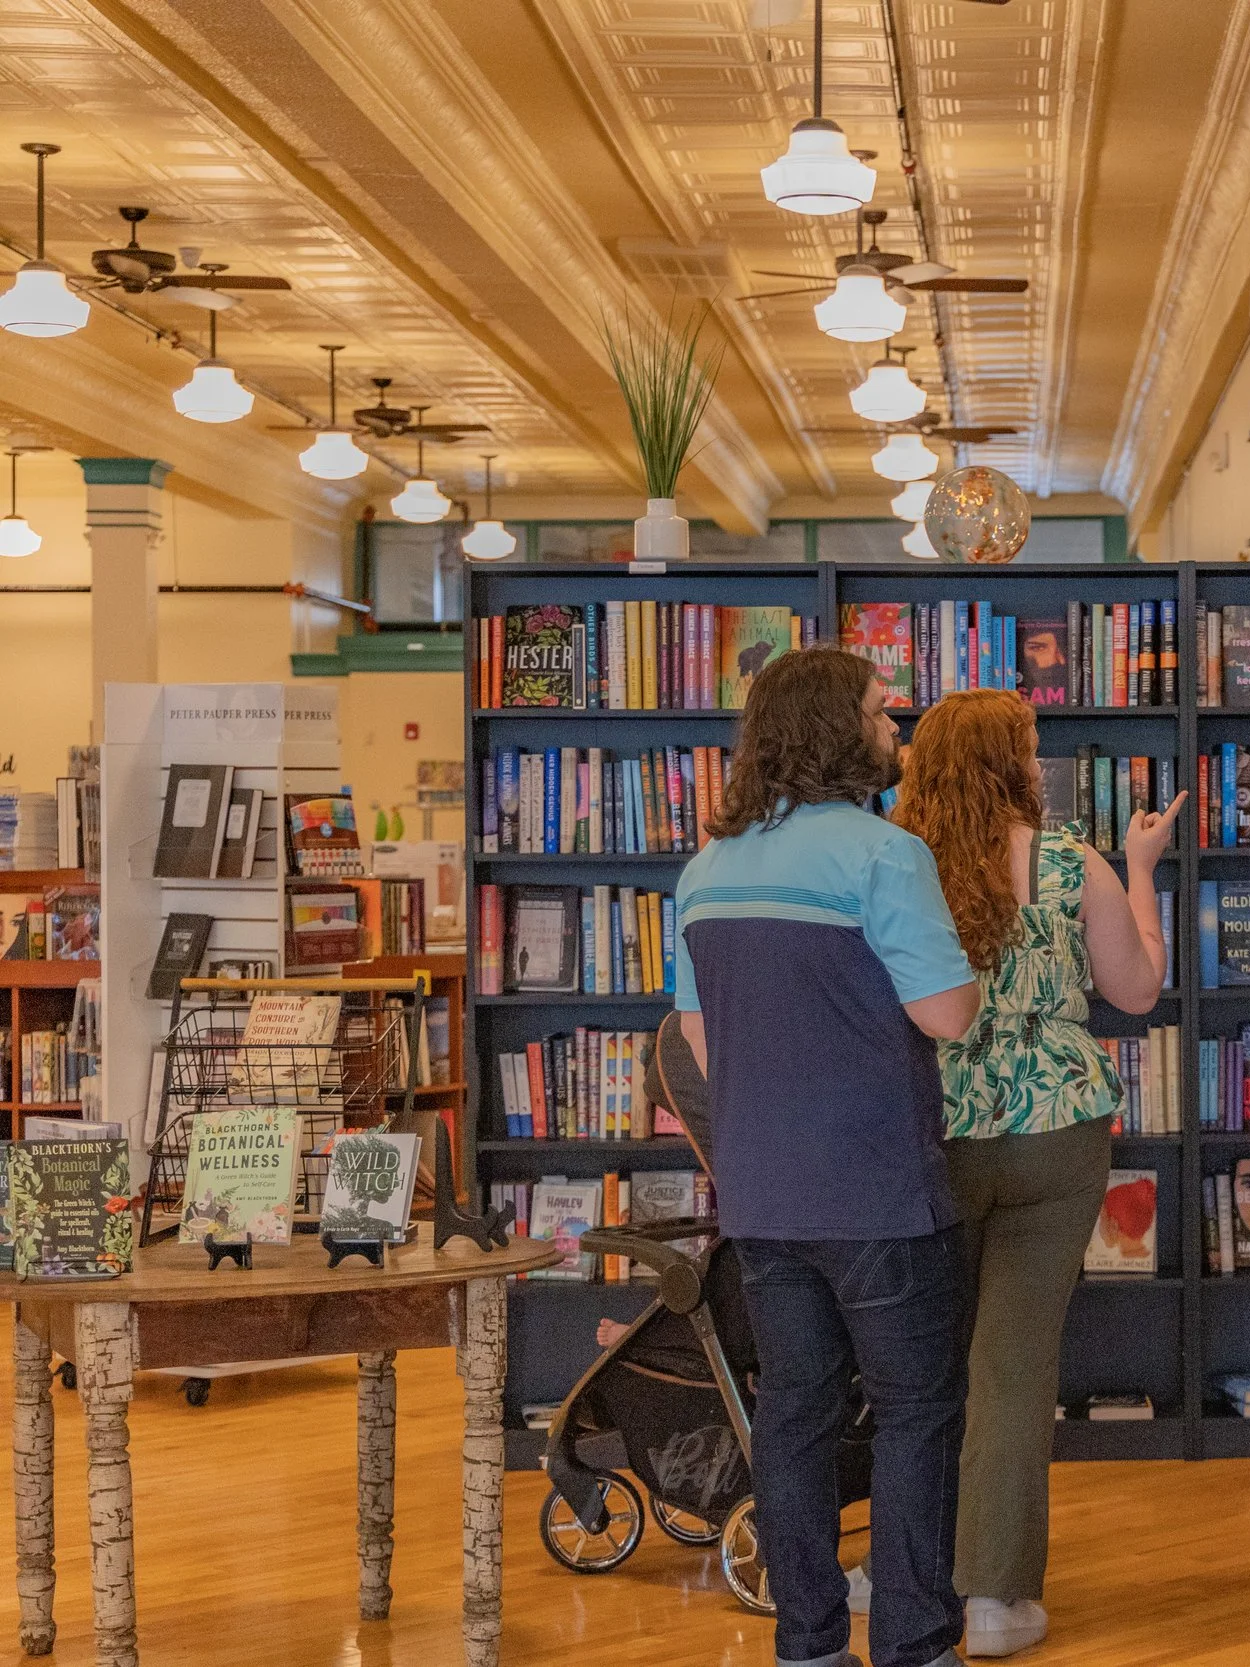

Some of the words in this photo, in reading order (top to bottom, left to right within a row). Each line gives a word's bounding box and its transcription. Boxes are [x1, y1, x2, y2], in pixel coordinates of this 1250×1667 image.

[587, 604, 596, 633] OTHER
[725, 610, 747, 625] THE
[754, 610, 783, 625] LAST
[730, 626, 781, 641] ANIMAL
[587, 637, 596, 662] BIRDS
[507, 645, 573, 670] HESTER
[1142, 671, 1152, 693] PARTNERS
[1164, 670, 1173, 692] PARTNERS
[1019, 686, 1066, 705] SAM
[170, 709, 201, 719] PETER
[203, 709, 242, 719] PAUPER
[244, 709, 277, 719] PRESS
[304, 711, 332, 720] PRESS
[672, 803, 681, 816] BE
[672, 819, 681, 840] YOU
[1227, 949, 1249, 959] KATE
[258, 1001, 305, 1011] MOUNTAIN
[255, 1014, 297, 1023] CONJURE
[251, 1026, 299, 1036] SOUTHERN
[32, 1142, 112, 1156] BLACKTHORN'S
[198, 1134, 285, 1152] BOTANICAL
[41, 1155, 101, 1174] Botanical
[199, 1153, 280, 1171] WELLNESS
[344, 1151, 400, 1170] WILD
[54, 1175, 91, 1197] Magic
[332, 1171, 406, 1191] WITCH
[54, 1199, 63, 1208] The
[78, 1198, 96, 1207] Witch's
[546, 1195, 584, 1209] HAYLEY
[50, 1210, 63, 1219] guide
[69, 1209, 91, 1217] essential
[91, 1208, 100, 1216] oils
[60, 1219, 68, 1227] for
[58, 1228, 71, 1237] ritual
[76, 1228, 94, 1238] healing
[57, 1245, 68, 1254] Amy
[69, 1244, 95, 1253] Blackthorn
